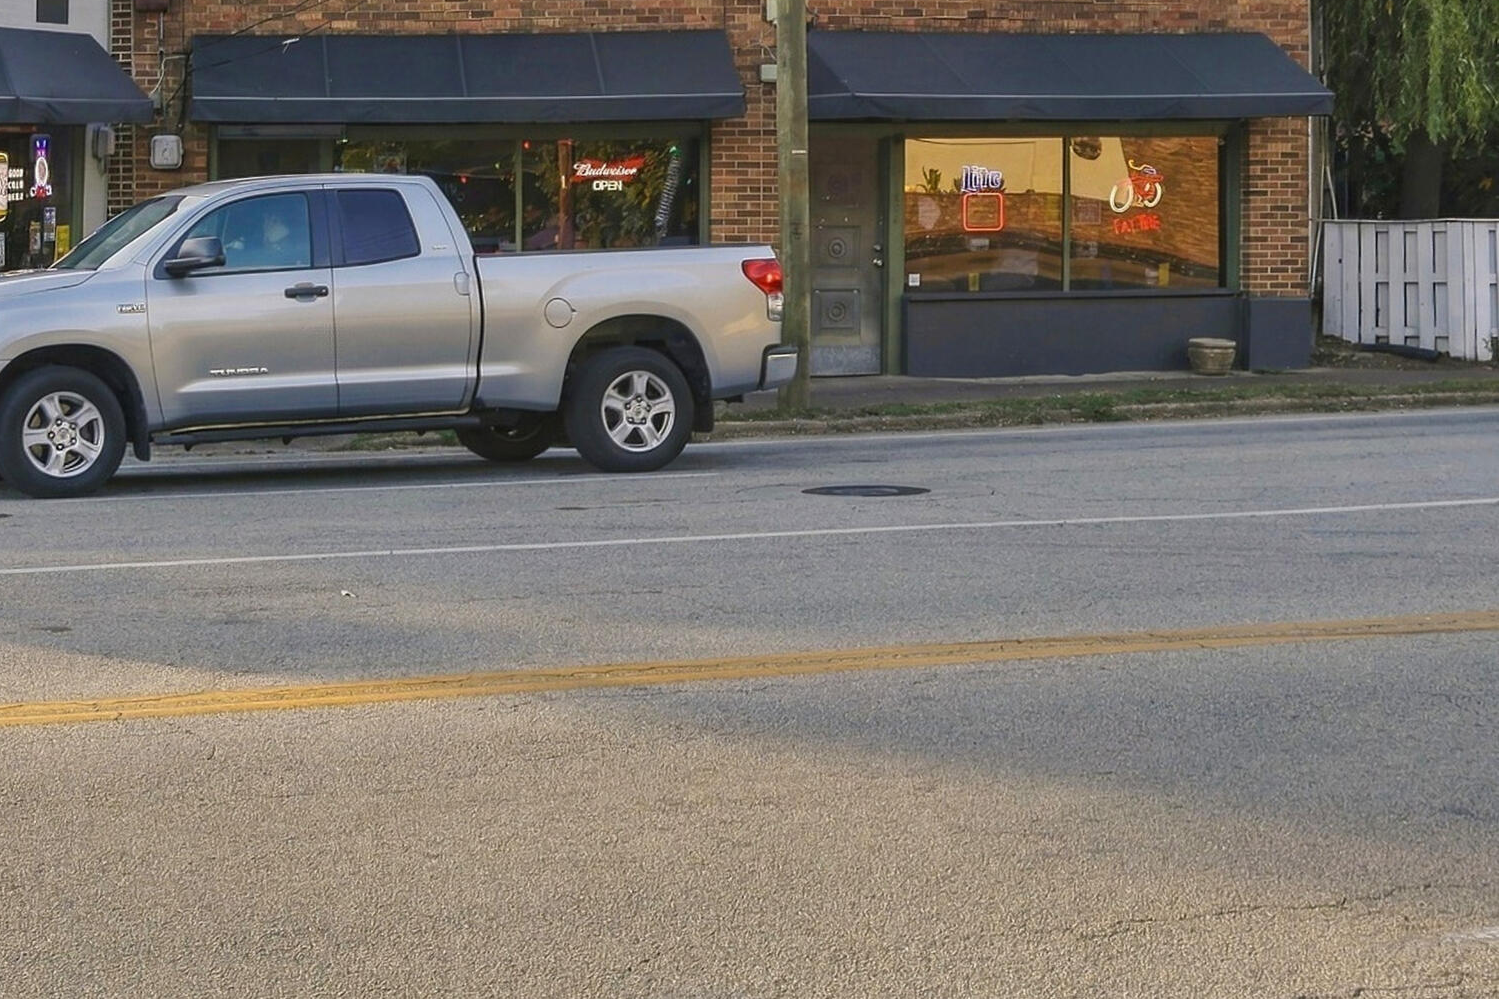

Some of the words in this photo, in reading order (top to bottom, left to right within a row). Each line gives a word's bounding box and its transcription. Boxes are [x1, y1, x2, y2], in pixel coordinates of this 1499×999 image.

[573, 162, 637, 177] Budweiser
[592, 180, 622, 191] OPEN
[961, 165, 1002, 192] Lite
